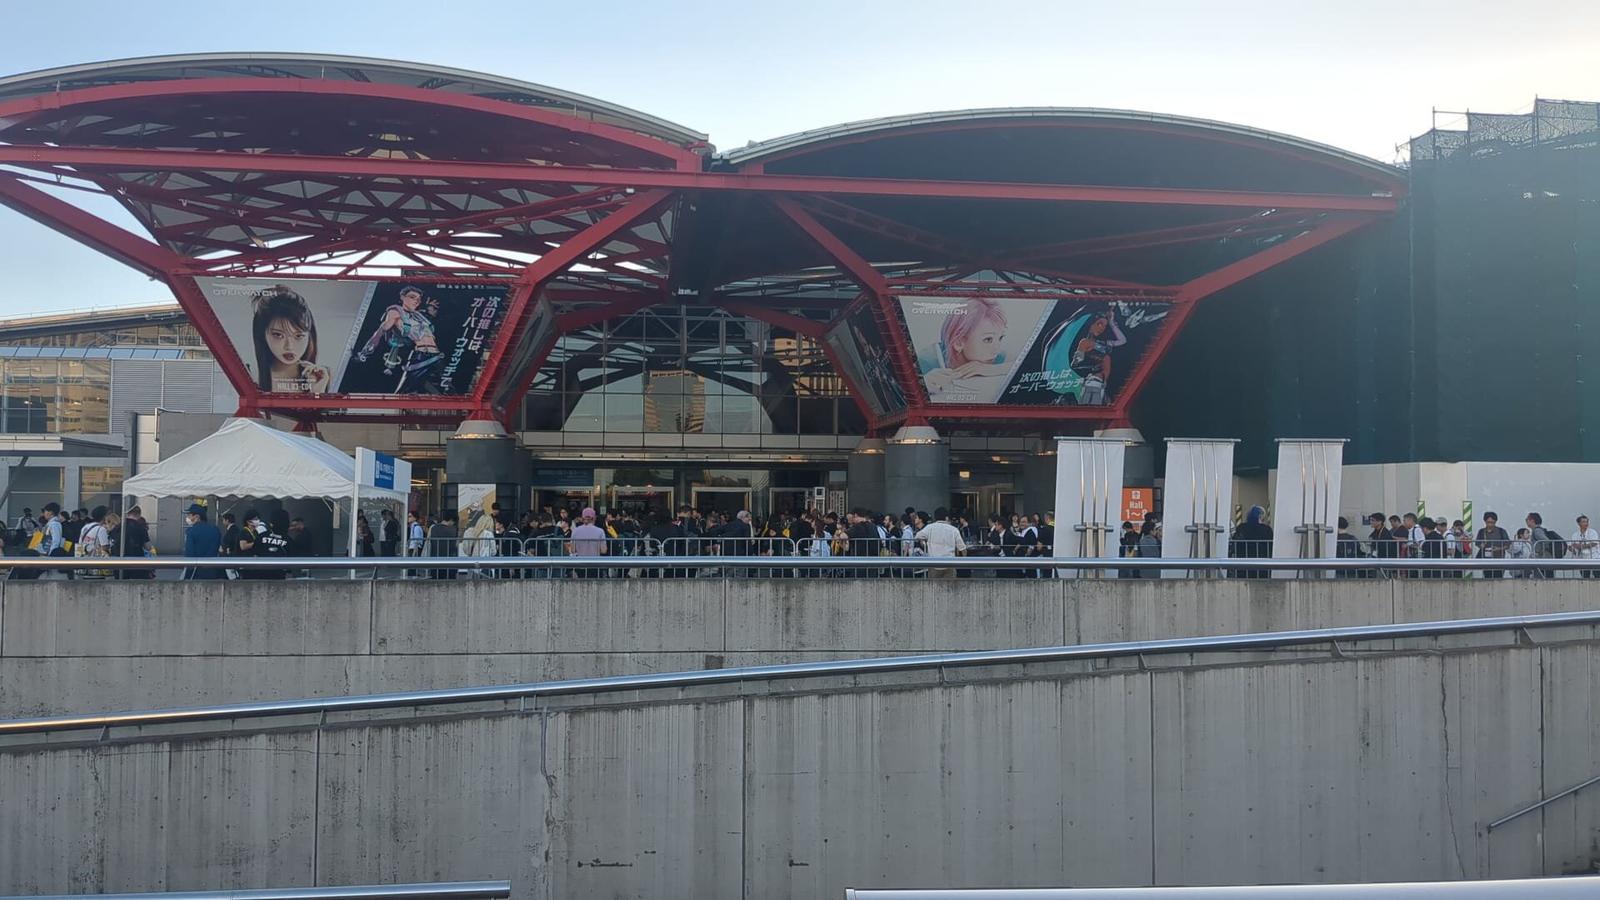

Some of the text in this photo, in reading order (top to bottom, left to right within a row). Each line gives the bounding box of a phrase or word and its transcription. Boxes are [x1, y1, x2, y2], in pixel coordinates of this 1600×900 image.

[911, 307, 969, 315] OVERWATCH
[1129, 501, 1143, 509] Hall
[261, 536, 288, 547] STAFF
